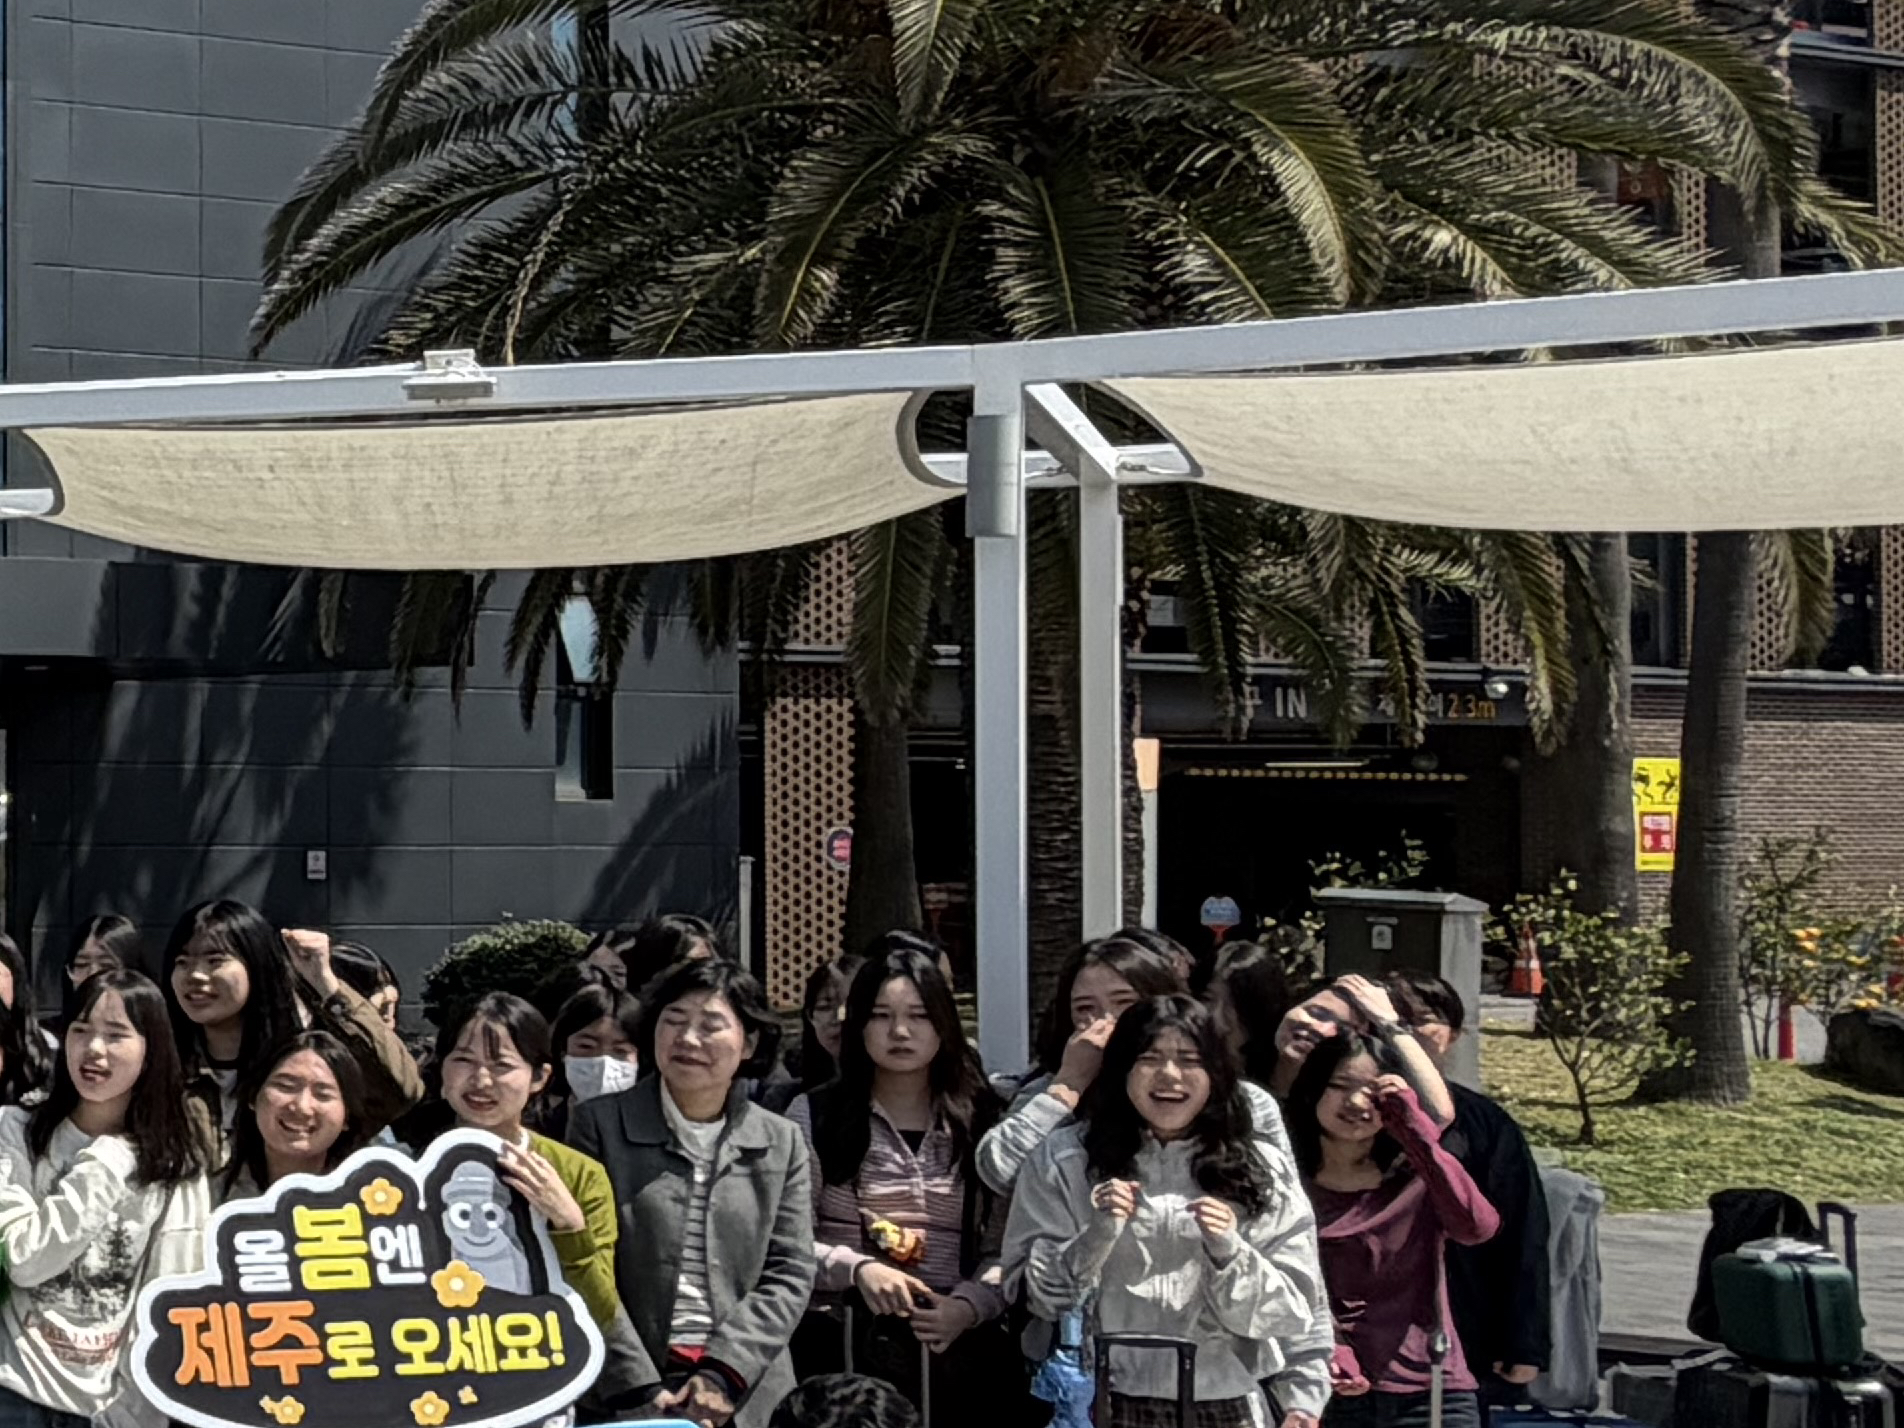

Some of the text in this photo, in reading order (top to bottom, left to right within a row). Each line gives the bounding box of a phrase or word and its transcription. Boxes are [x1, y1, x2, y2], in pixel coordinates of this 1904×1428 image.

[1275, 686, 1308, 718] IN
[167, 1299, 566, 1388] 제주로 오세요!
